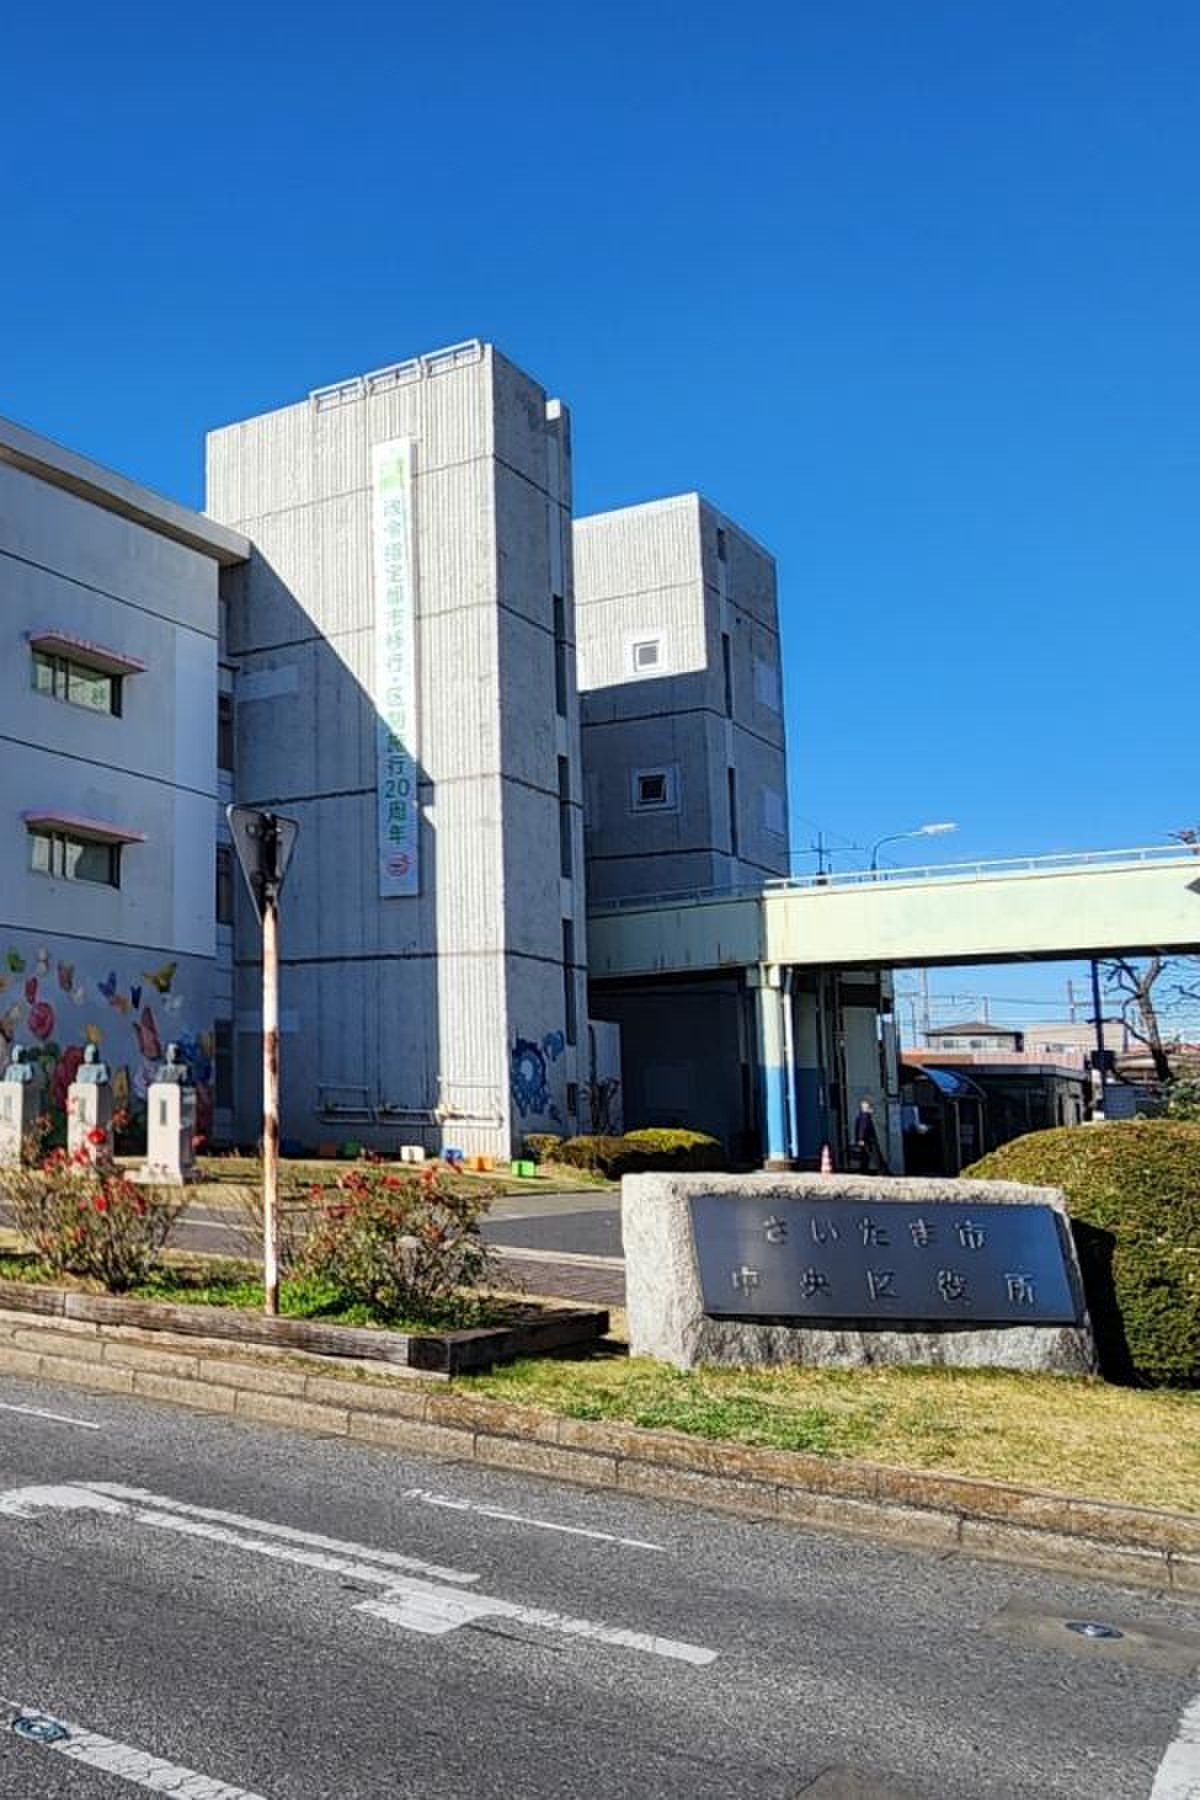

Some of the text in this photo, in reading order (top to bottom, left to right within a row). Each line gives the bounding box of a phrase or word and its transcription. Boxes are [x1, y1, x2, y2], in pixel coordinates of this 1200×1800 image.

[763, 1215, 990, 1249] さいたま市
[731, 1266, 1037, 1306] 中央区役所
